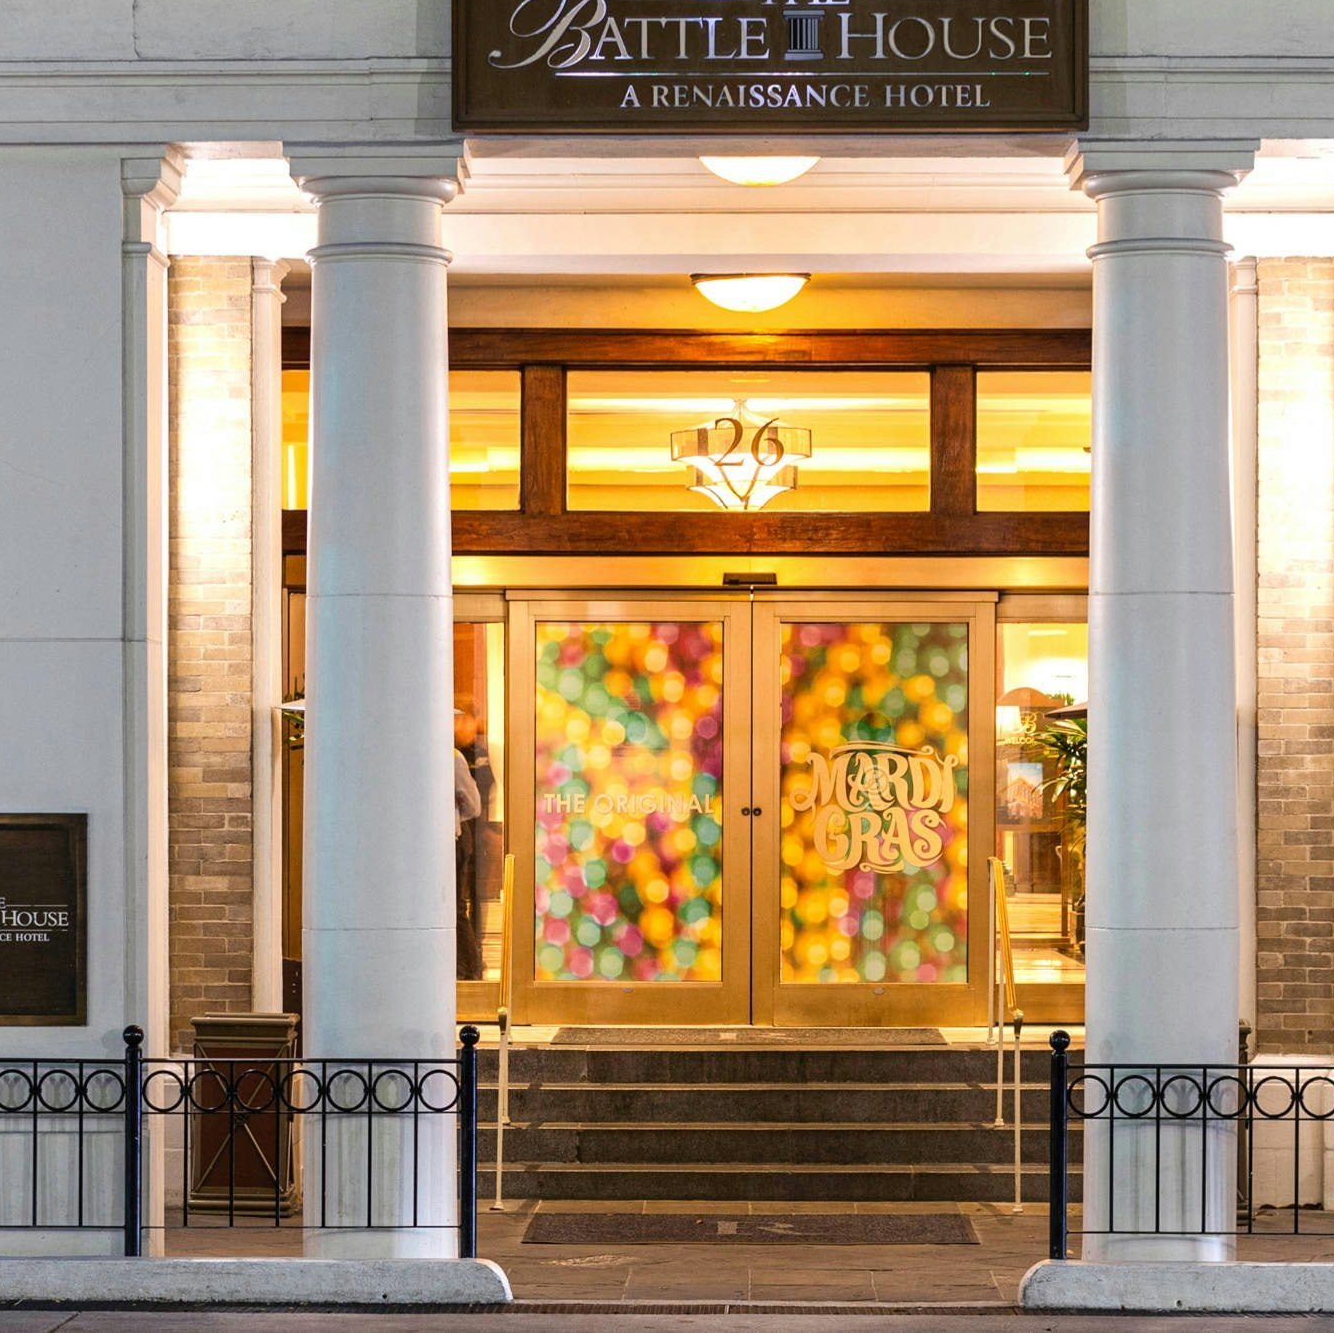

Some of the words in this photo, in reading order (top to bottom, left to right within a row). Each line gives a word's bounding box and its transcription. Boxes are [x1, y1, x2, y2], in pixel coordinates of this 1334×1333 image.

[838, 12, 1052, 60] HOUSE
[620, 84, 640, 108] A
[652, 84, 870, 108] RENAISSANCE
[885, 84, 990, 108] HOTEL
[713, 417, 785, 467] 26
[790, 740, 958, 813] MARDI
[544, 794, 585, 814] THE
[594, 794, 715, 814] ORIGINAL
[813, 805, 946, 874] GRAS
[2, 911, 68, 926] HOUSE
[16, 934, 49, 942] HOTEL
